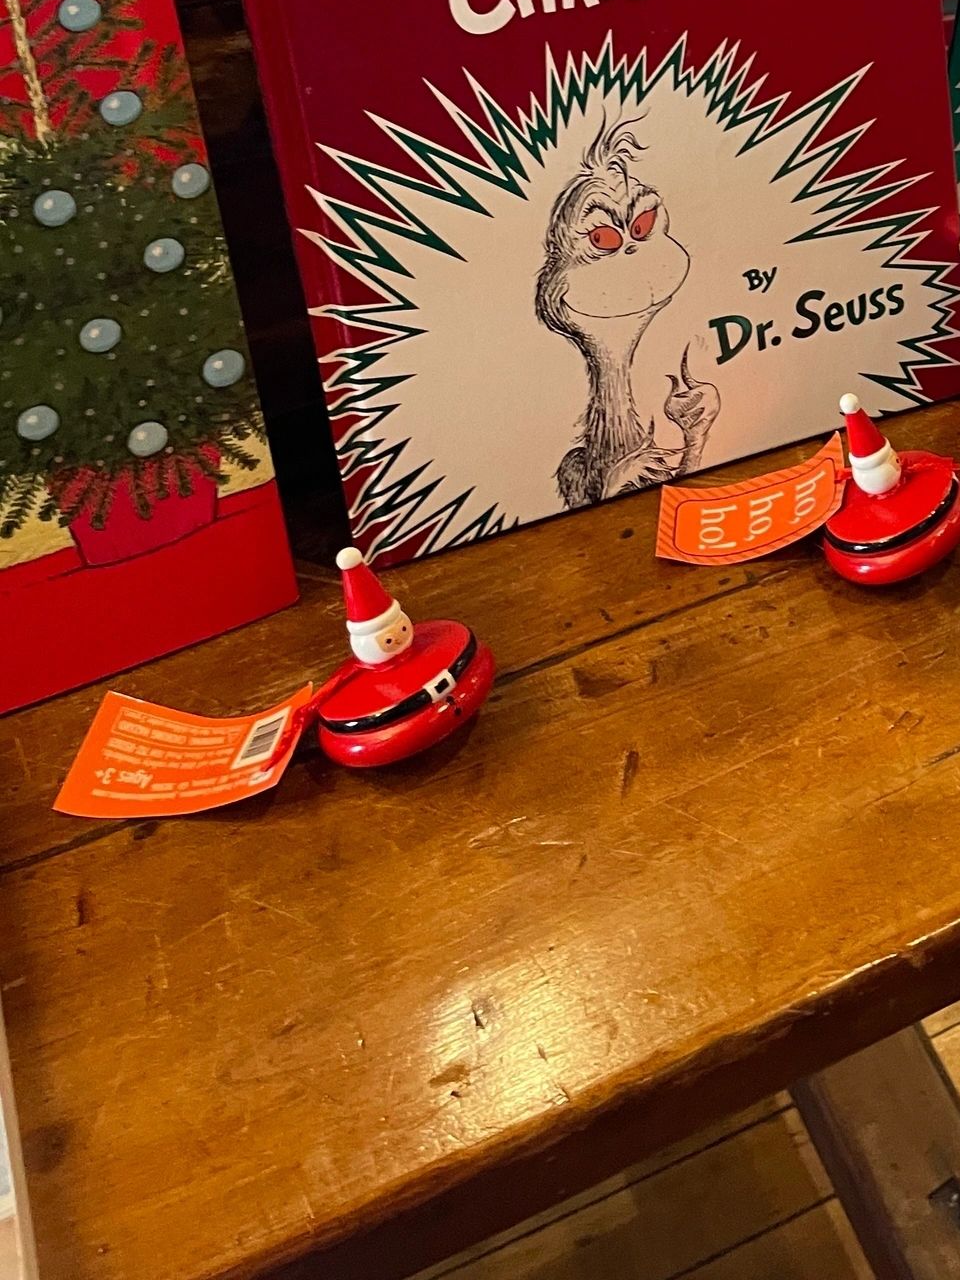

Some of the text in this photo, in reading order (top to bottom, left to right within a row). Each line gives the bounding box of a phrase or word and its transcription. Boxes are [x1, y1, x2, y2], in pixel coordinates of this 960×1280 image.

[742, 266, 778, 293] By
[708, 283, 905, 365] Dr. Seuss
[745, 492, 784, 542] ho,
[789, 470, 826, 525] ho,
[698, 504, 737, 551] ho!
[115, 768, 153, 789] Ages
